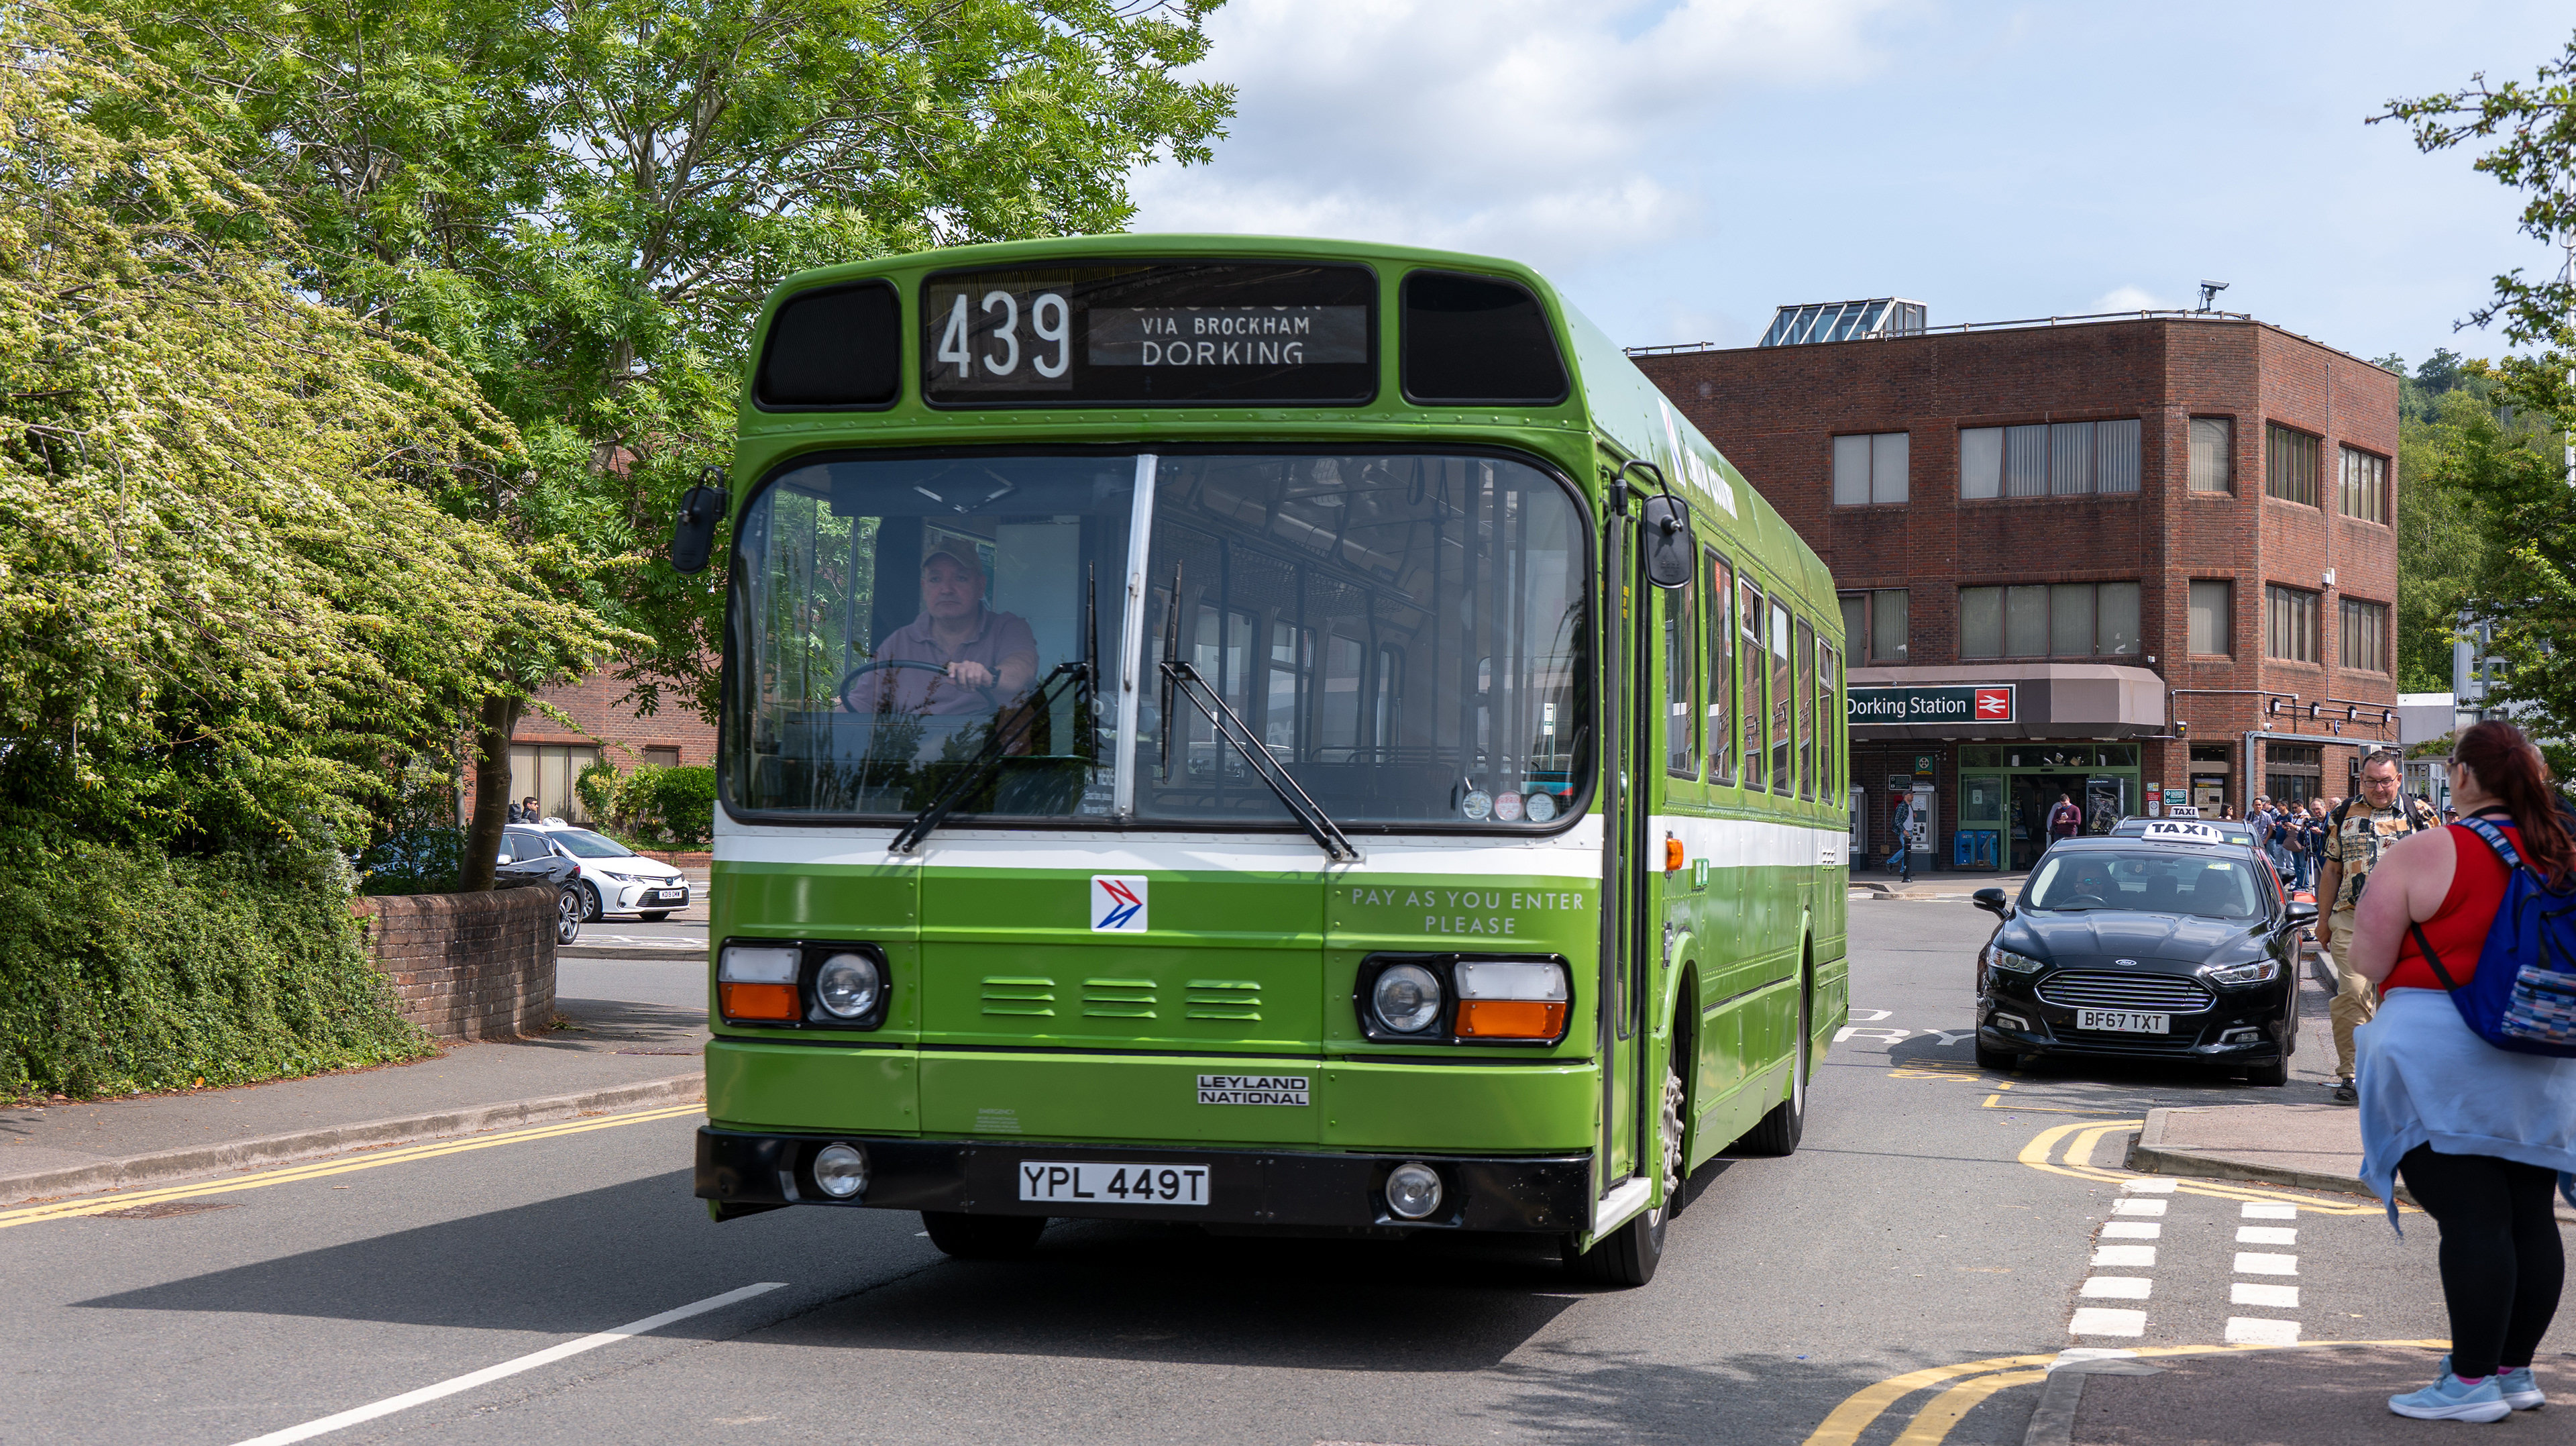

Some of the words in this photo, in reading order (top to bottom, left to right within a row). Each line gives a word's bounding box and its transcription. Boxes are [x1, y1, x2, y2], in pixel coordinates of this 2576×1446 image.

[937, 290, 1070, 379] 439
[1142, 317, 1178, 335] VIA
[1194, 317, 1311, 335] BROCKHAM
[1142, 341, 1304, 366] DORKING
[1847, 697, 1906, 718] Dorking
[1910, 696, 1966, 714] Station
[2152, 823, 2208, 835] TAXI
[1352, 888, 1396, 905] PAY
[1405, 890, 1436, 907] AS
[1446, 891, 1500, 909] YOU
[1512, 893, 1584, 910] ENTER
[1426, 916, 1516, 934] PLEASE
[2084, 1011, 2126, 1028] BF67
[2131, 1014, 2161, 1030] TXT
[1199, 1076, 1307, 1090] LEYLAND
[1199, 1091, 1307, 1105] NATIONAL
[1024, 1166, 1095, 1198] YPL
[1108, 1168, 1205, 1201] 449T
